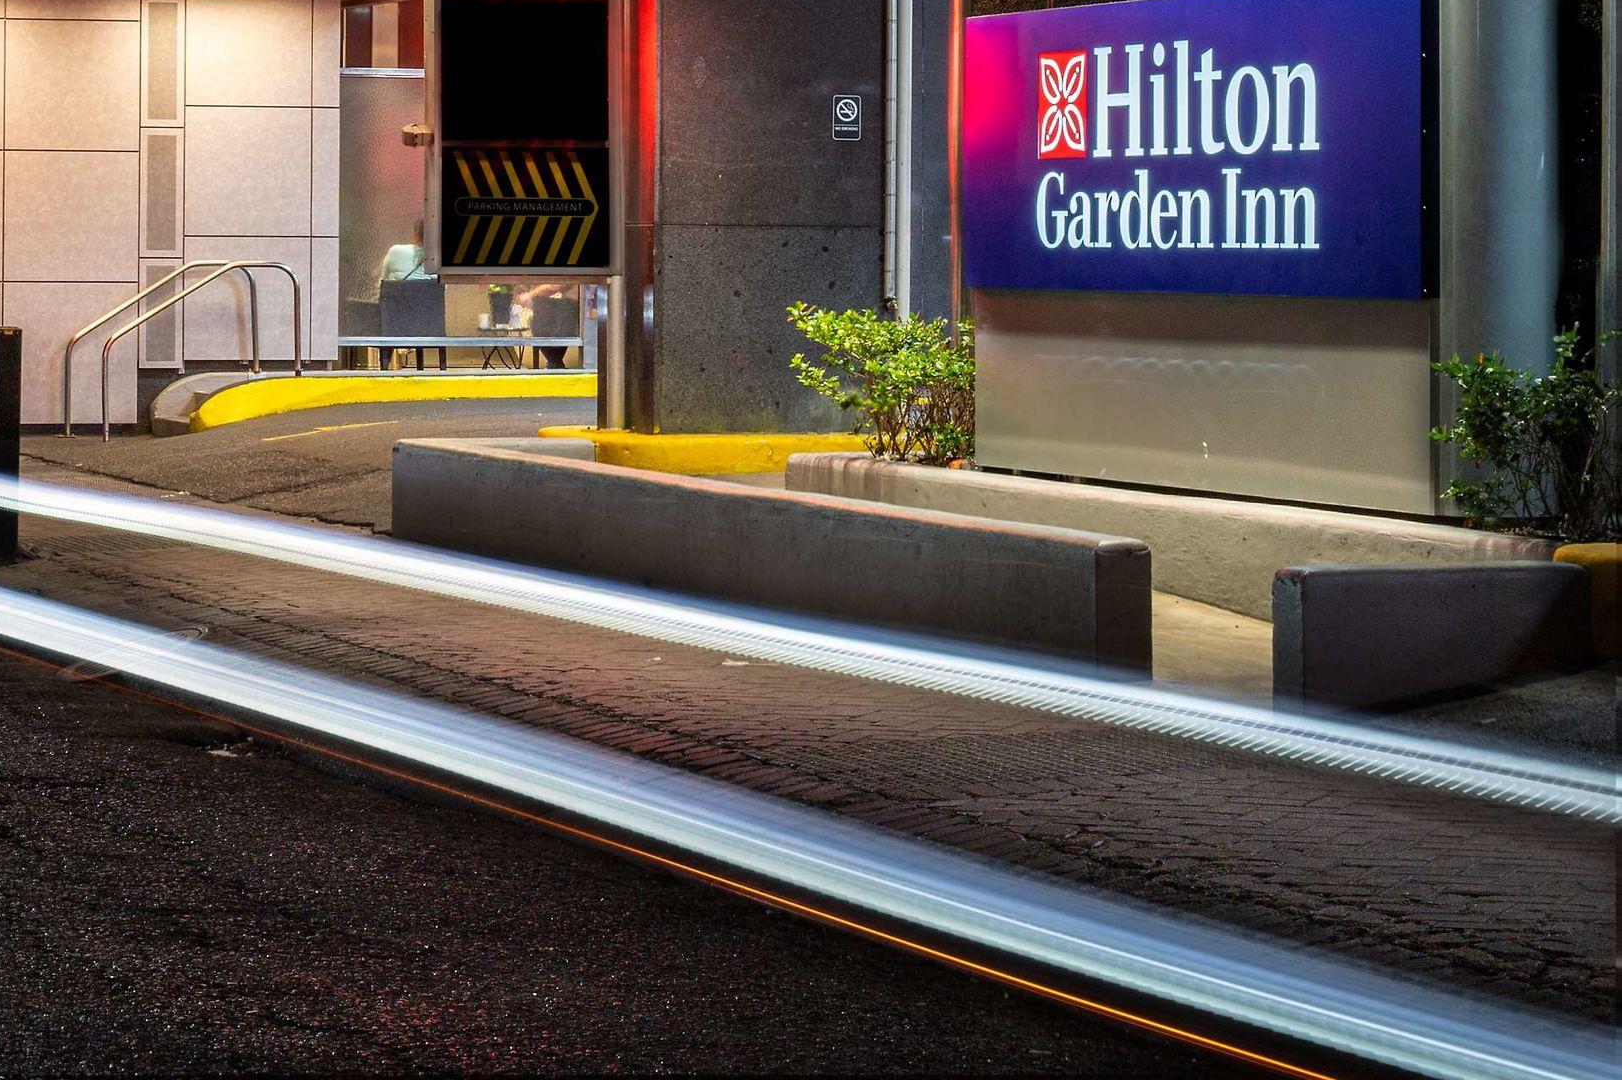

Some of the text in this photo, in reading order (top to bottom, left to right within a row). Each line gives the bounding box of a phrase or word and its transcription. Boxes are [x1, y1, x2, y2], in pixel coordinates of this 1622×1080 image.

[1093, 40, 1320, 158] Hilton
[467, 202, 583, 212] PARKING MANAGEMENT
[1036, 168, 1320, 249] Garden Inn
